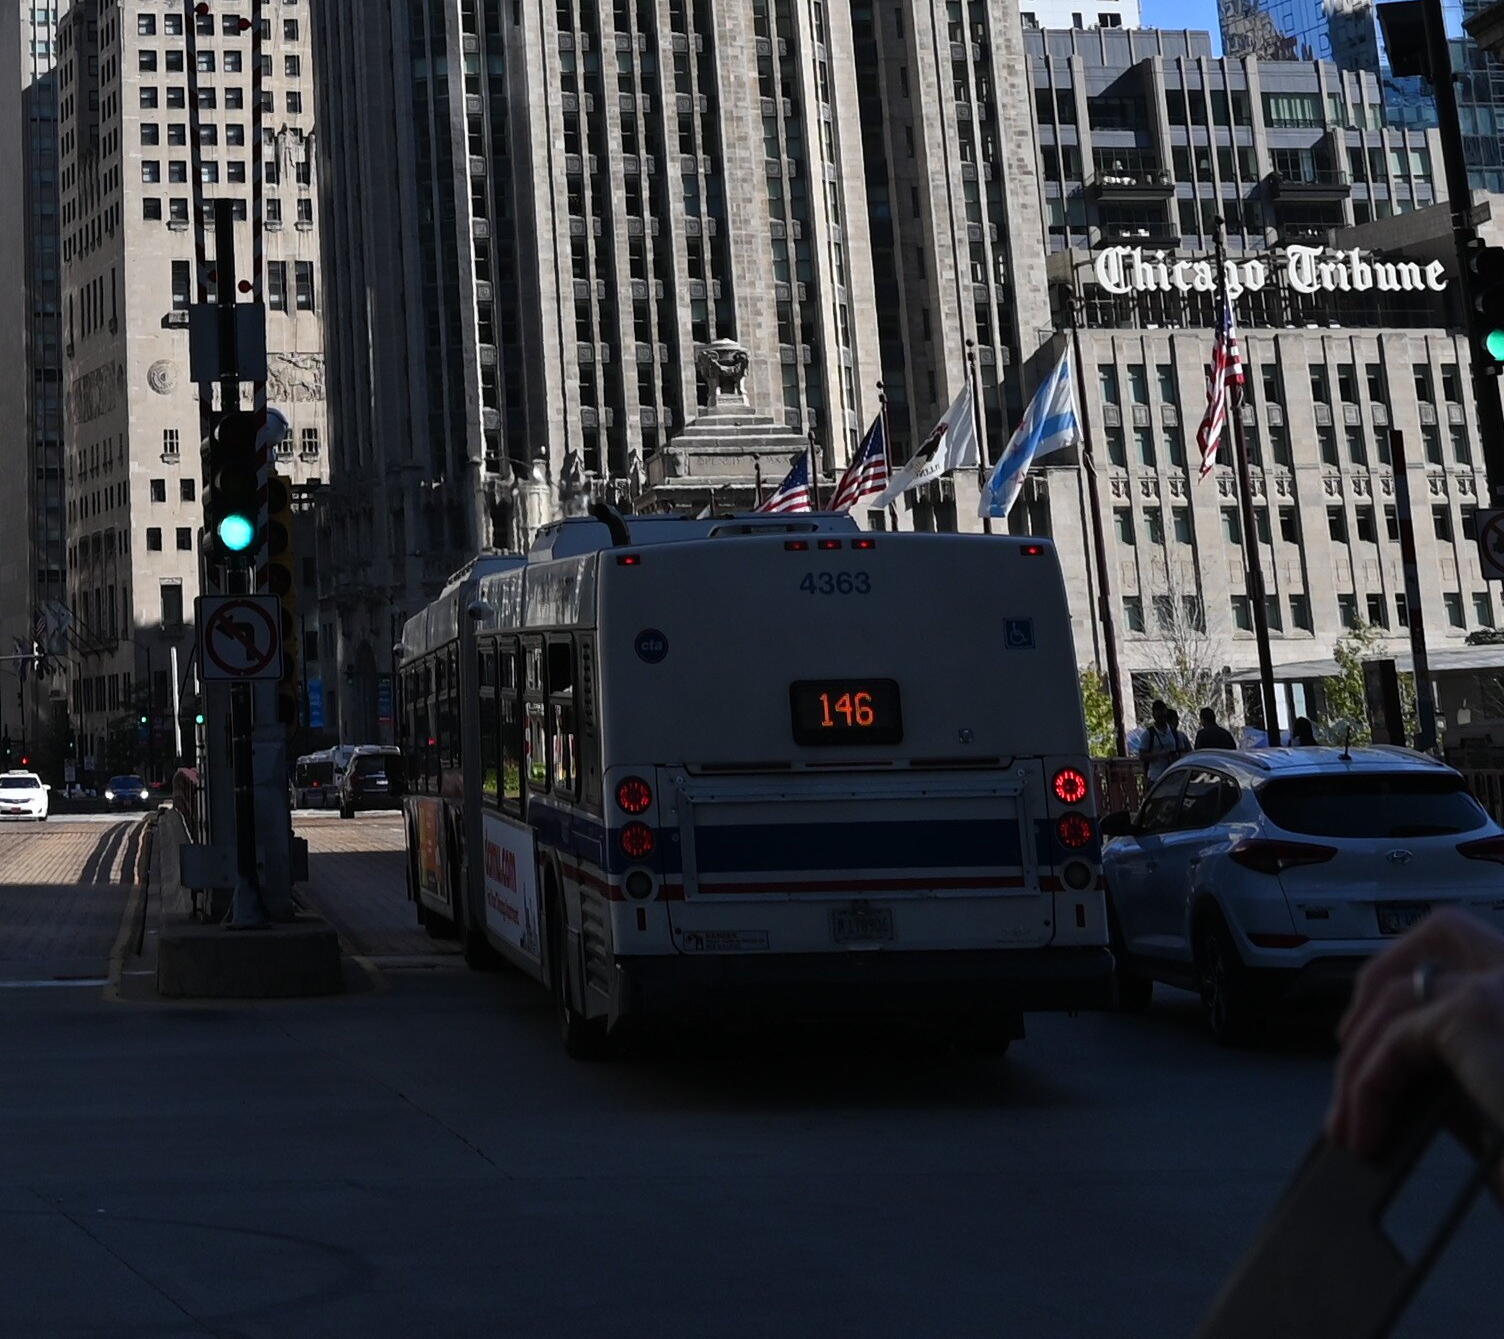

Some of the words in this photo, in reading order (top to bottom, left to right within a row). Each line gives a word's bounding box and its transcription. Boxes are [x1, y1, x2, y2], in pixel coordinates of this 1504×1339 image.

[1095, 245, 1271, 300] Chicago
[1286, 244, 1450, 294] Tribune
[800, 571, 872, 595] 4363
[641, 639, 663, 652] cta
[819, 690, 875, 727] 146
